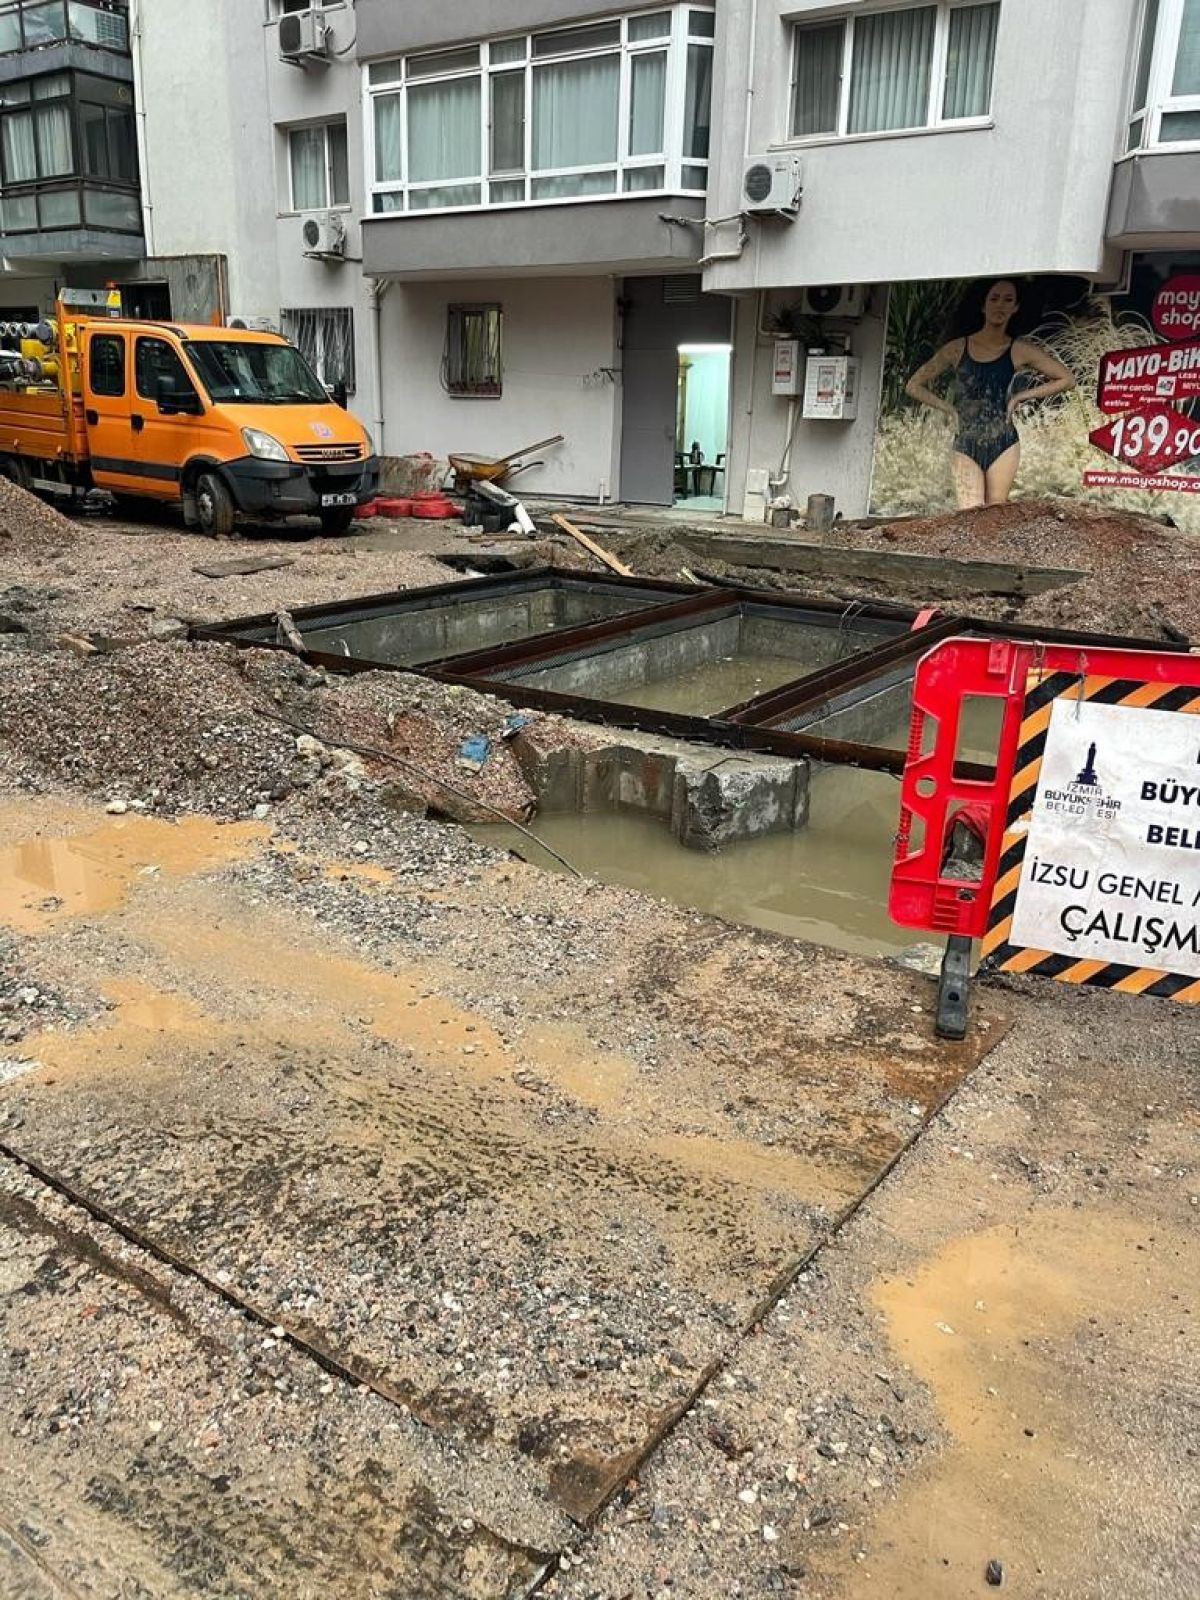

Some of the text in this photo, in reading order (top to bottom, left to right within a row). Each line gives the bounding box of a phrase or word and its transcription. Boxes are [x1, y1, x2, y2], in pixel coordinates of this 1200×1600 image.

[1140, 777, 1200, 806] BÜY
[1030, 856, 1089, 890] İZSU
[1097, 873, 1183, 905] GENEL
[1060, 904, 1200, 954] ÇALIŞM
